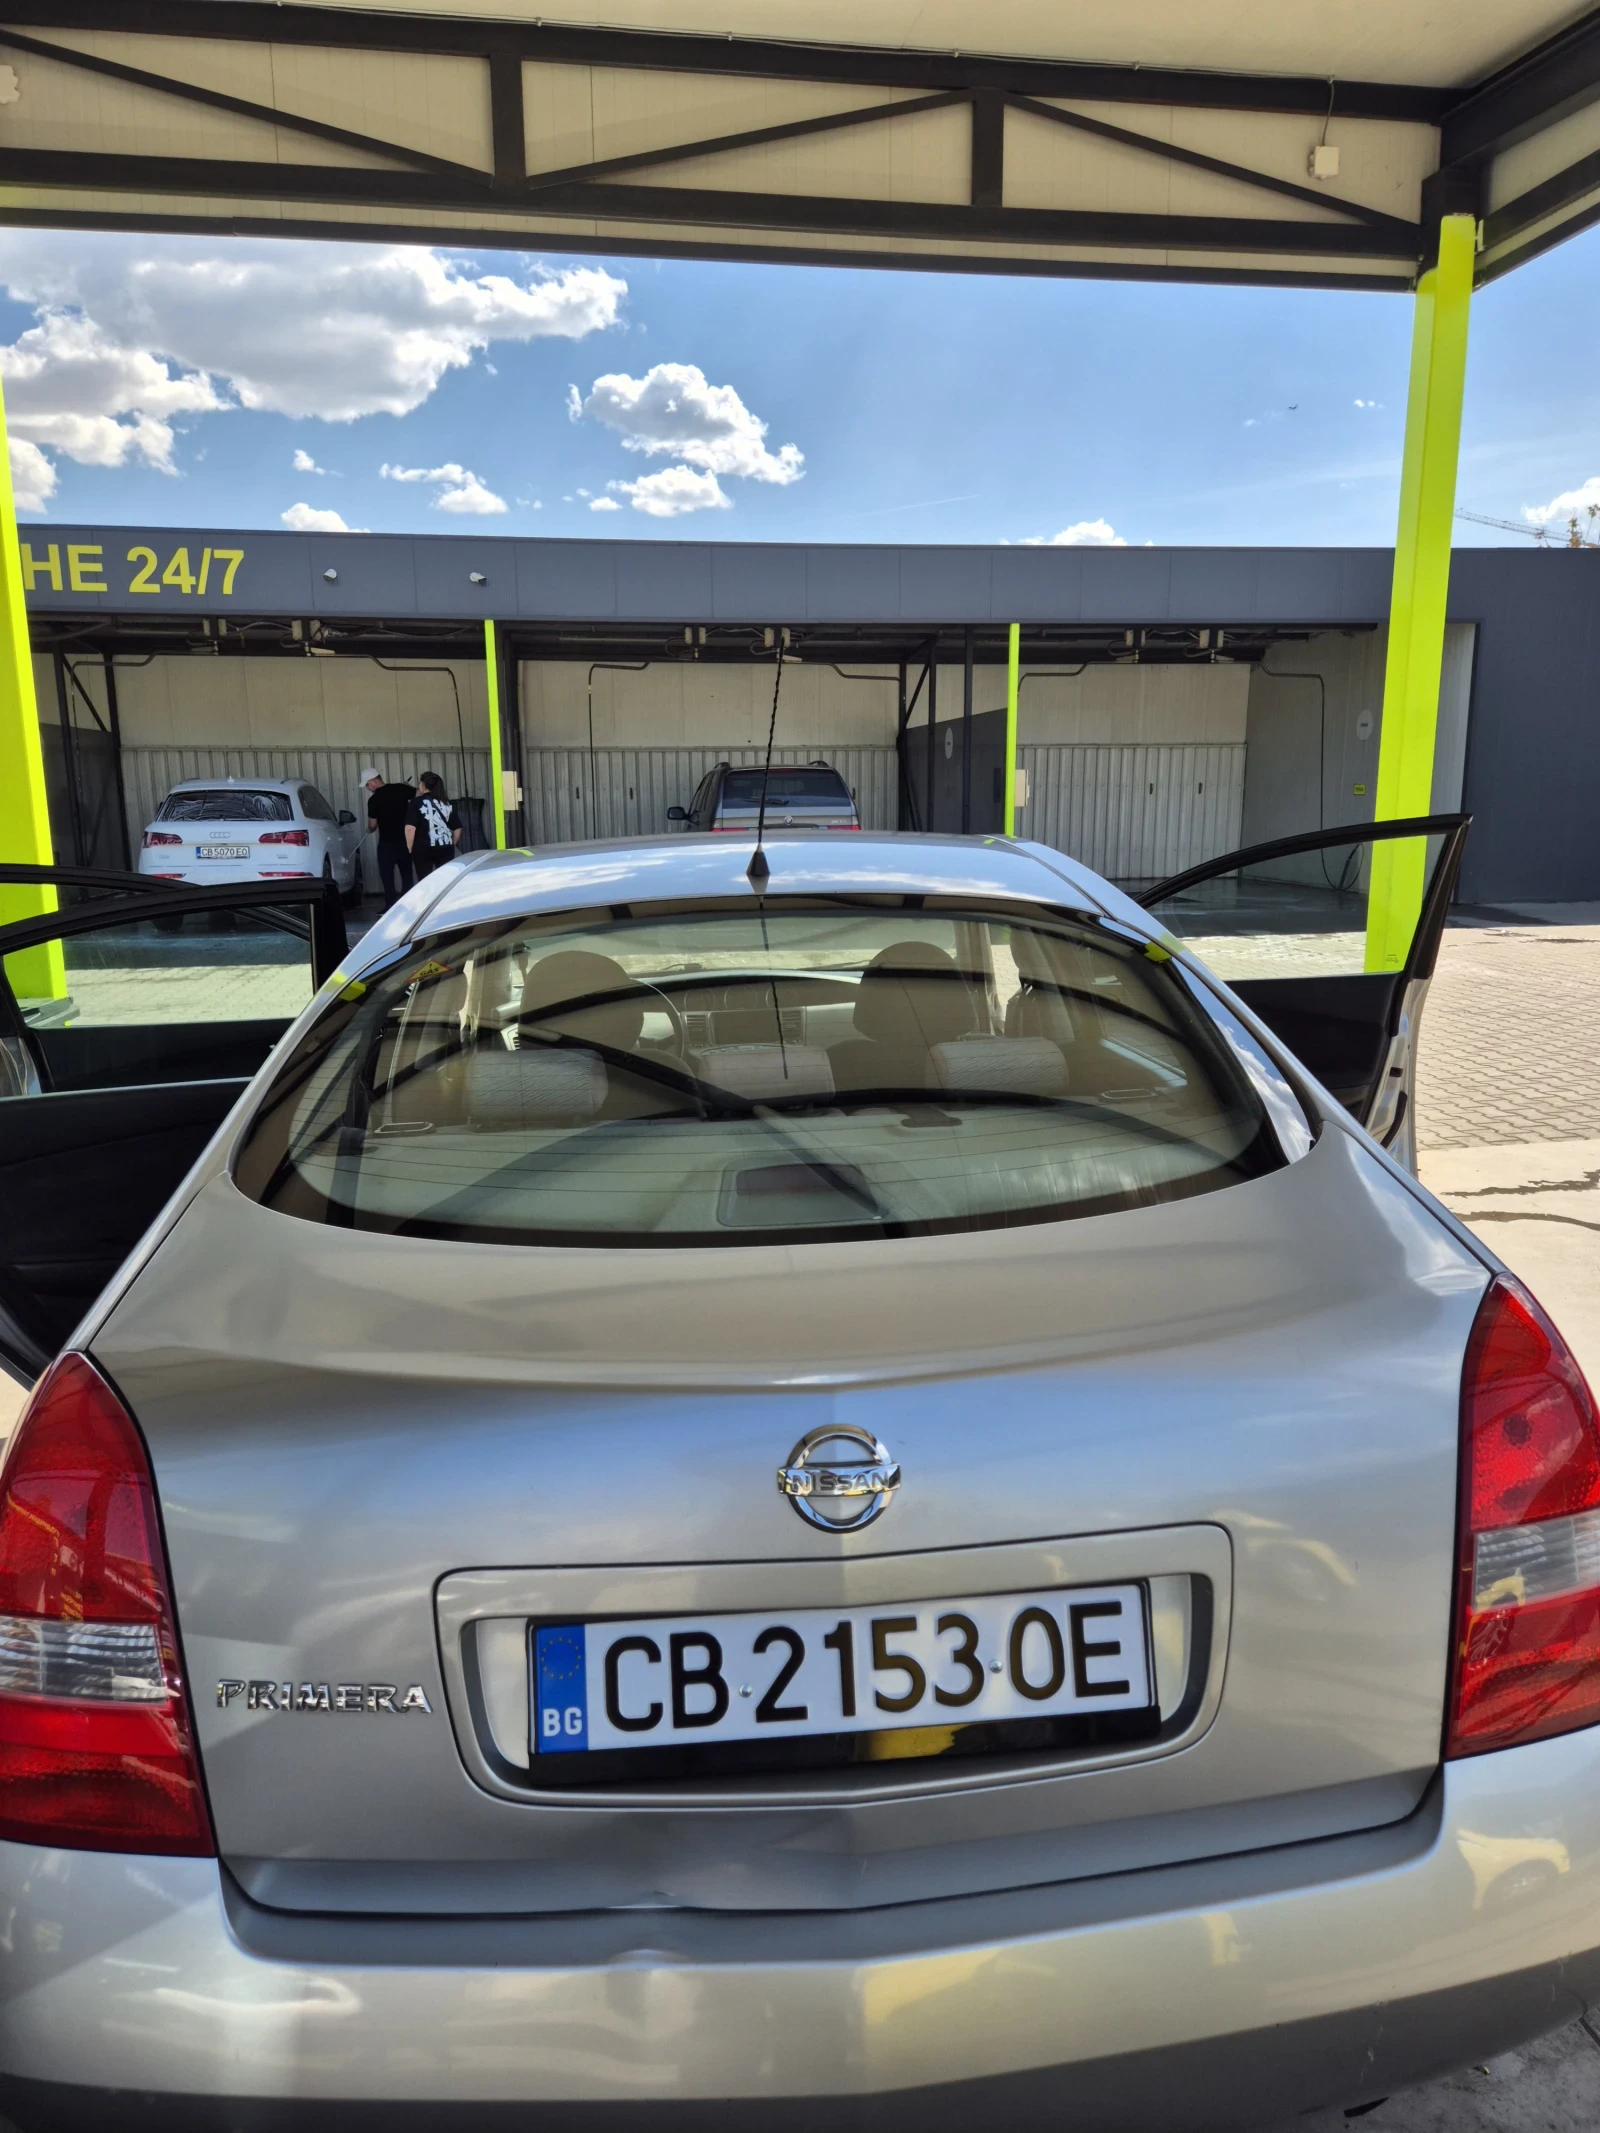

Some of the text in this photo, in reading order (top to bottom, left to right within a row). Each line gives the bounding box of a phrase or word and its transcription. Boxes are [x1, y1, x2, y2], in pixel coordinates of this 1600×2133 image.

[126, 546, 245, 595] 24/7
[201, 848, 213, 856] CB
[214, 848, 235, 856] 5070
[791, 1471, 889, 1492] NISSAN
[604, 1631, 730, 1733] CB
[751, 1613, 986, 1724] 2153
[216, 1678, 434, 1714] PRIMERA
[543, 1706, 583, 1738] BG
